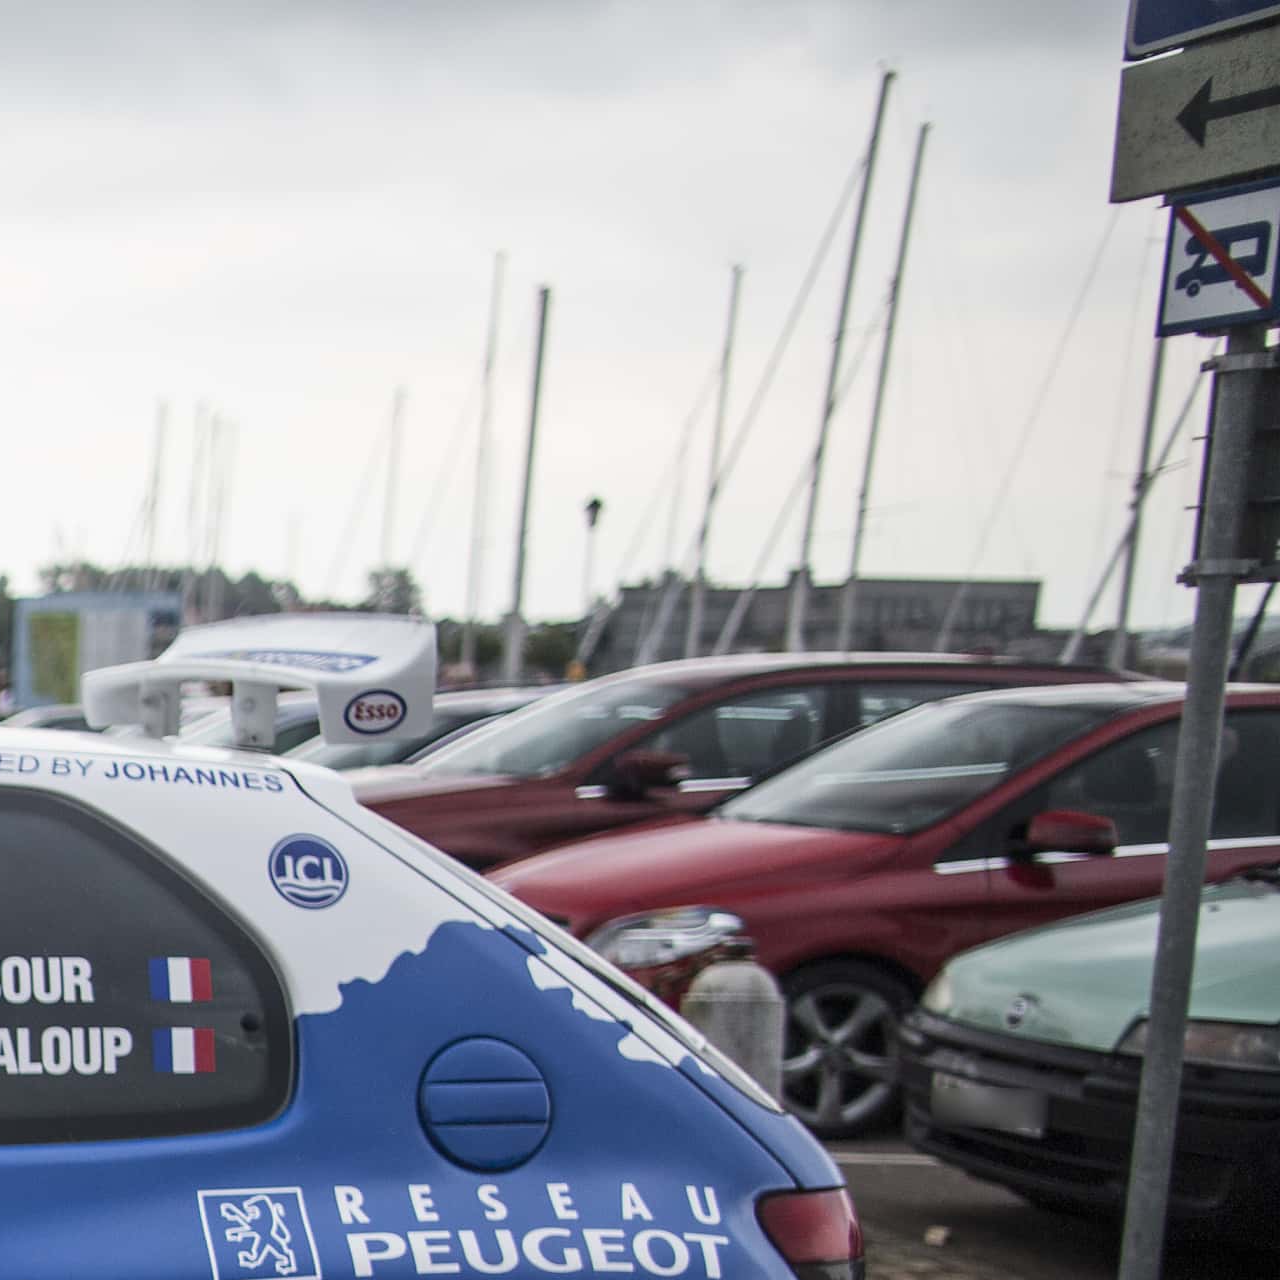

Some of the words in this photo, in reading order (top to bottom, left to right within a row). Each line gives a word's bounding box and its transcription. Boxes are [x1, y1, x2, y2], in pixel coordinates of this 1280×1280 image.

[353, 702, 399, 722] Esso
[51, 758, 94, 777] BY
[104, 760, 284, 793] JOHANNES
[335, 1183, 722, 1225] RESEAU
[346, 1227, 730, 1280] PEUGEOT
